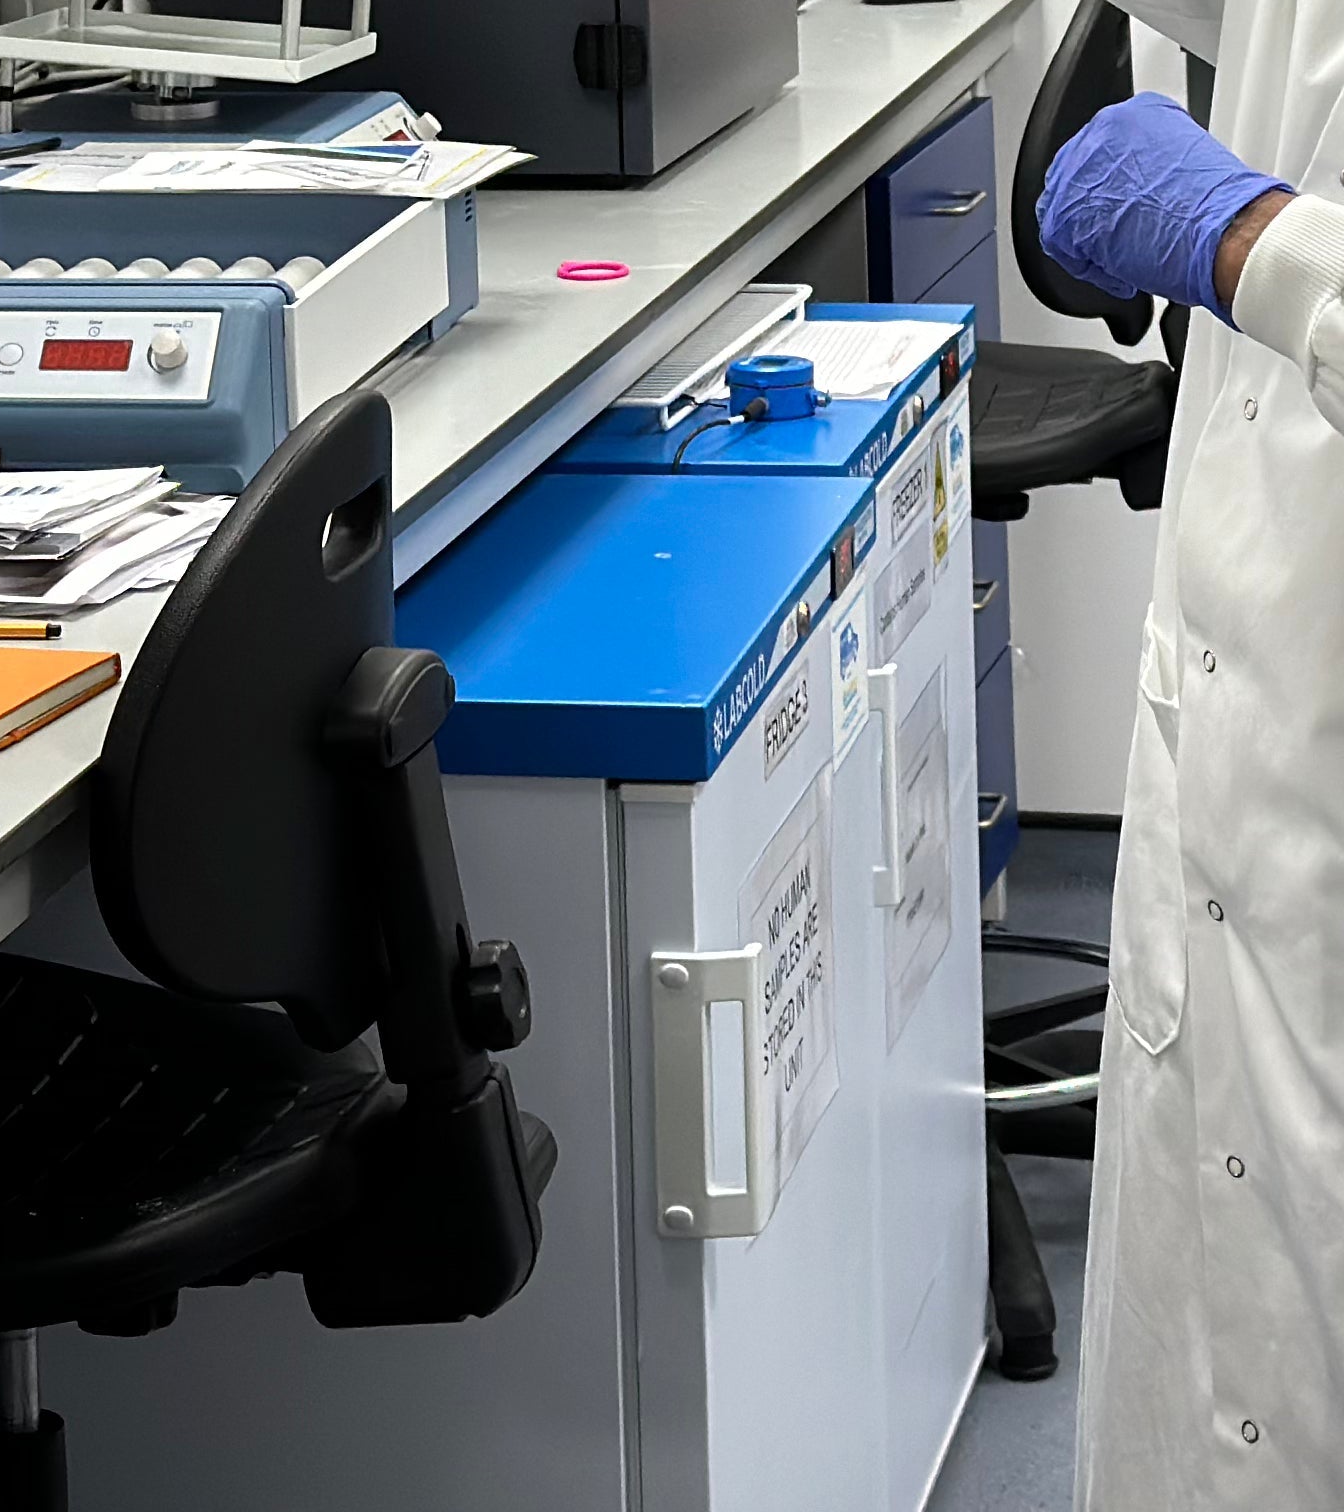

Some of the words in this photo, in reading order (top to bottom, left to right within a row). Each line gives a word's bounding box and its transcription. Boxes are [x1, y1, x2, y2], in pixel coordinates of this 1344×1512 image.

[723, 653, 766, 740] LABCOLD
[766, 687, 801, 764] FRIDGE
[768, 905, 780, 951] NO
[781, 864, 811, 928] HUMAN
[765, 930, 802, 1015] SAMPLES
[803, 902, 819, 956] ARE
[764, 998, 795, 1076] STORED
[796, 980, 806, 1019] IN
[806, 950, 824, 1001] THIS
[784, 1037, 804, 1093] UNIT
